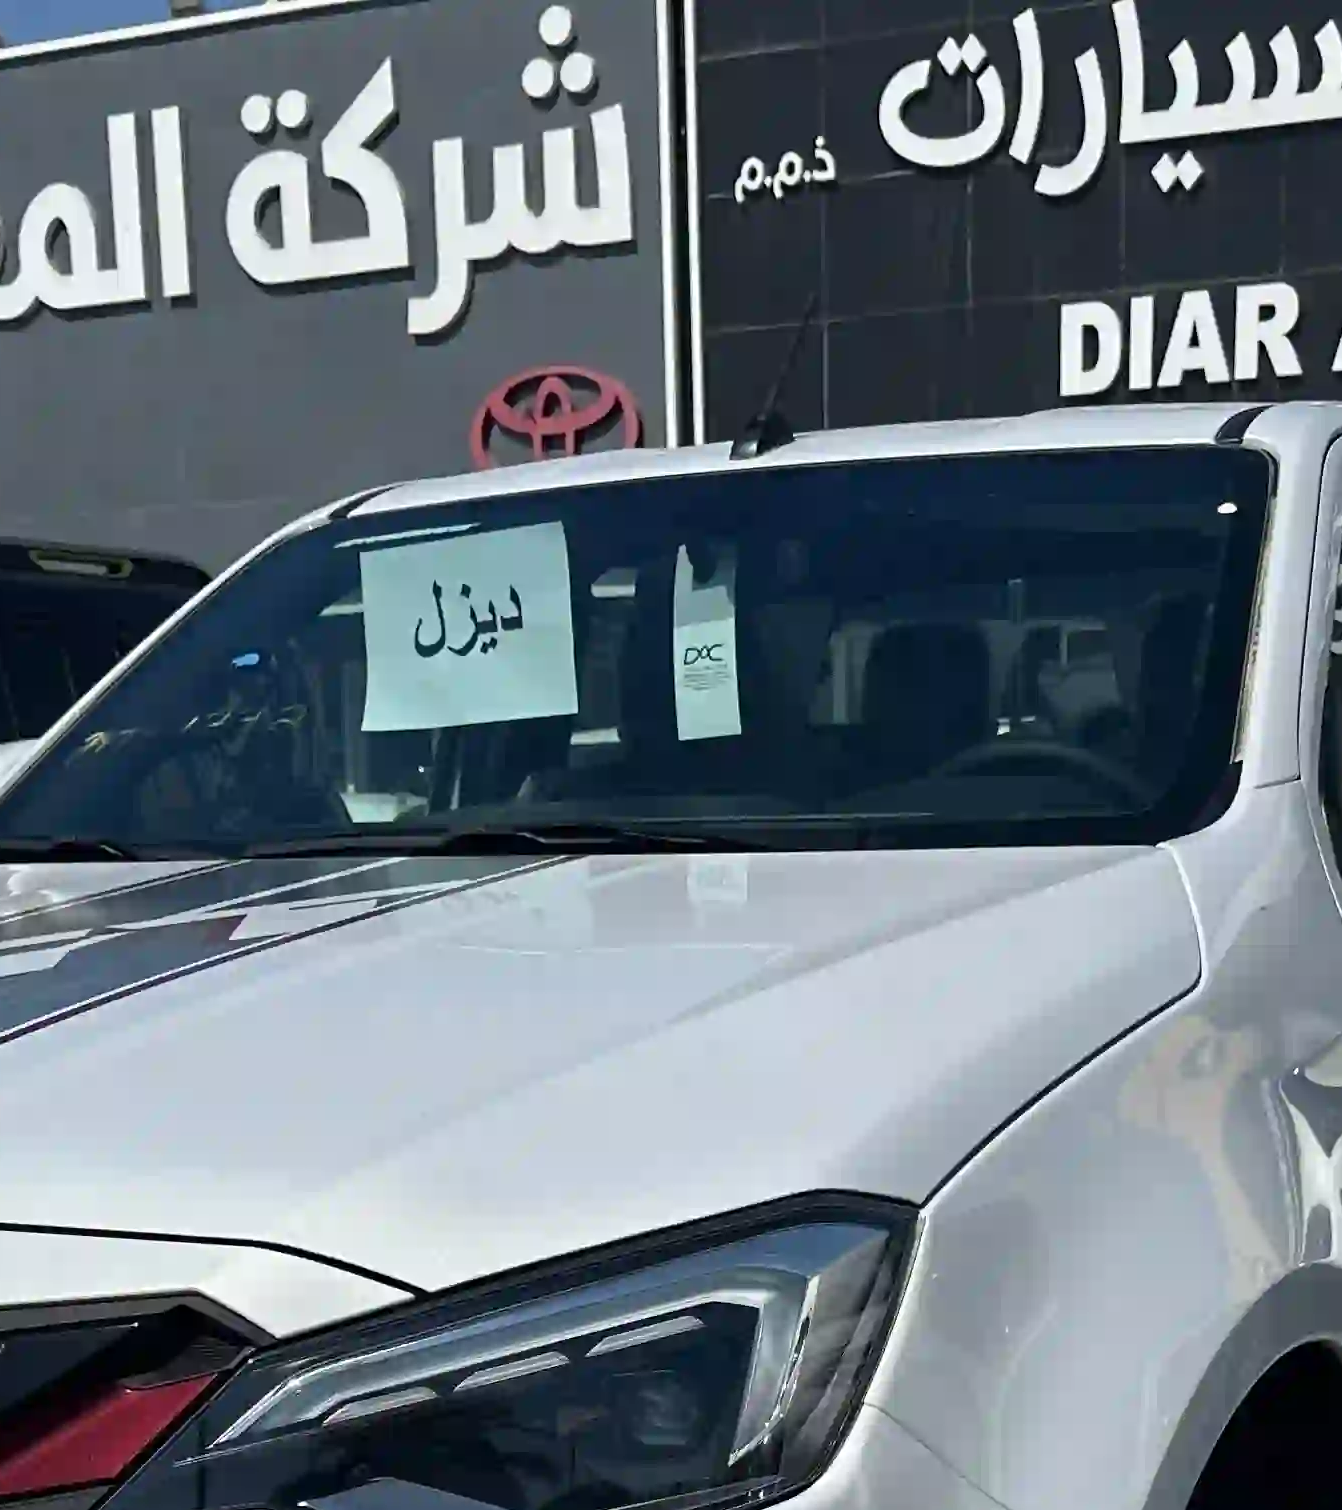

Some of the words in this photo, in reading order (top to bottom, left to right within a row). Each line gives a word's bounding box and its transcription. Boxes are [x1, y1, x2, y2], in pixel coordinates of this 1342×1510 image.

[226, 5, 632, 334] شركة
[734, 135, 836, 203] ذ.م.م
[1059, 282, 1303, 397] DIAR
[414, 580, 524, 658] ديزل
